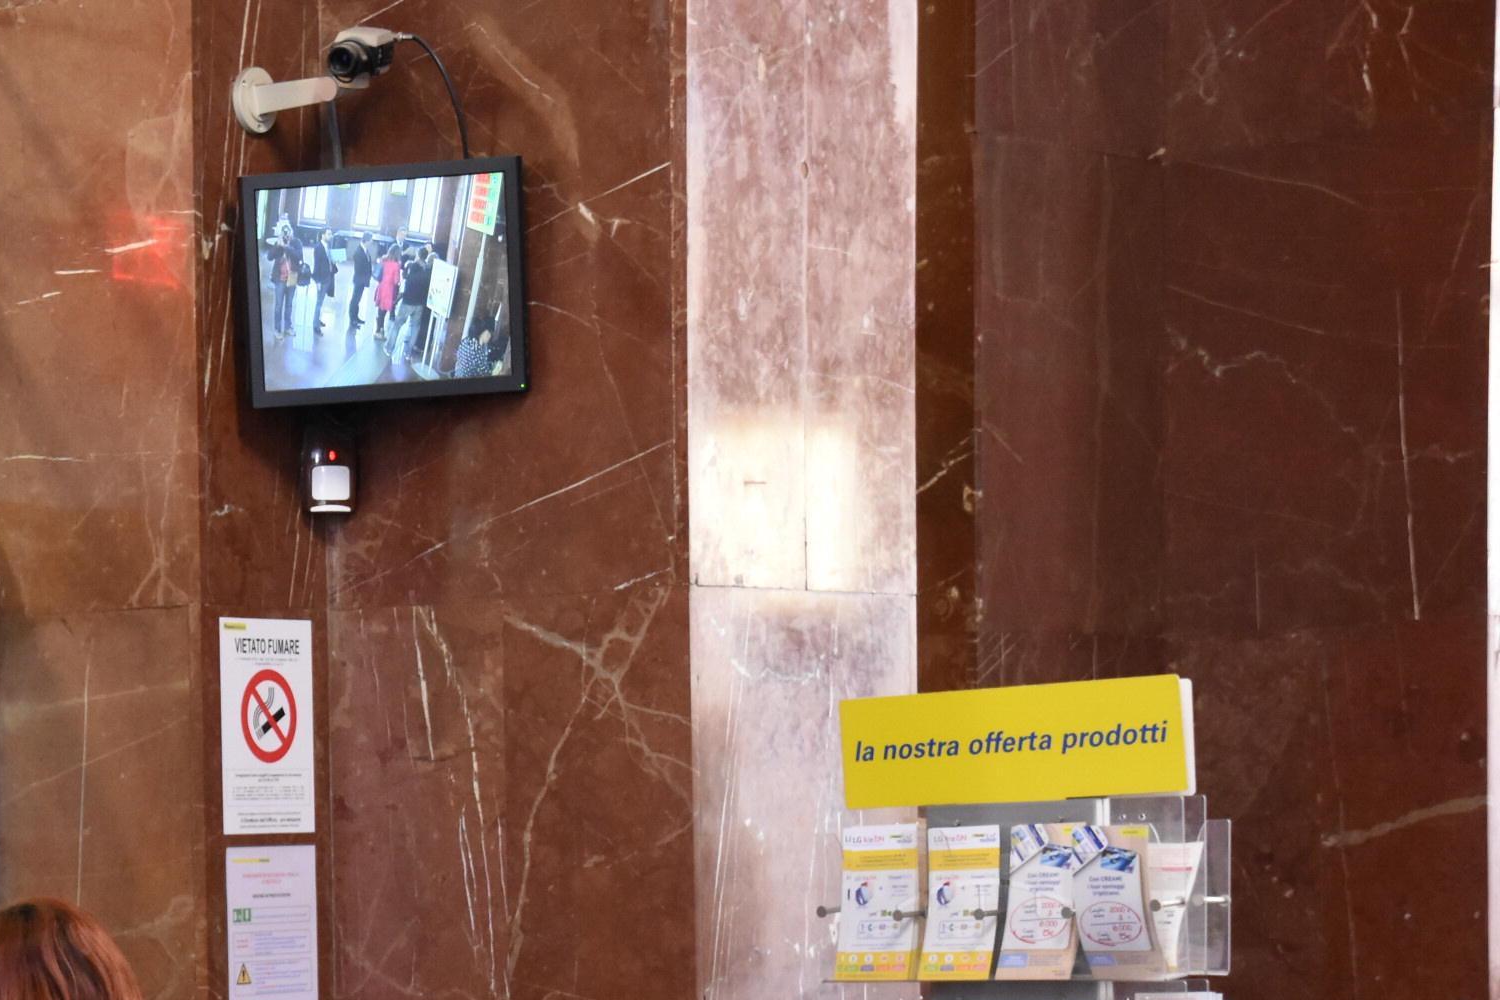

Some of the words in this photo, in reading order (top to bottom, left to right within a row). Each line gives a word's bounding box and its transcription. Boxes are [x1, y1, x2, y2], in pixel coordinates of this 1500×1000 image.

[234, 637, 266, 654] VIETATO
[267, 638, 300, 655] FUMARE
[855, 740, 875, 762] la
[883, 738, 960, 760] nostra
[968, 731, 1052, 756] offerta
[1061, 720, 1169, 754] prodotti
